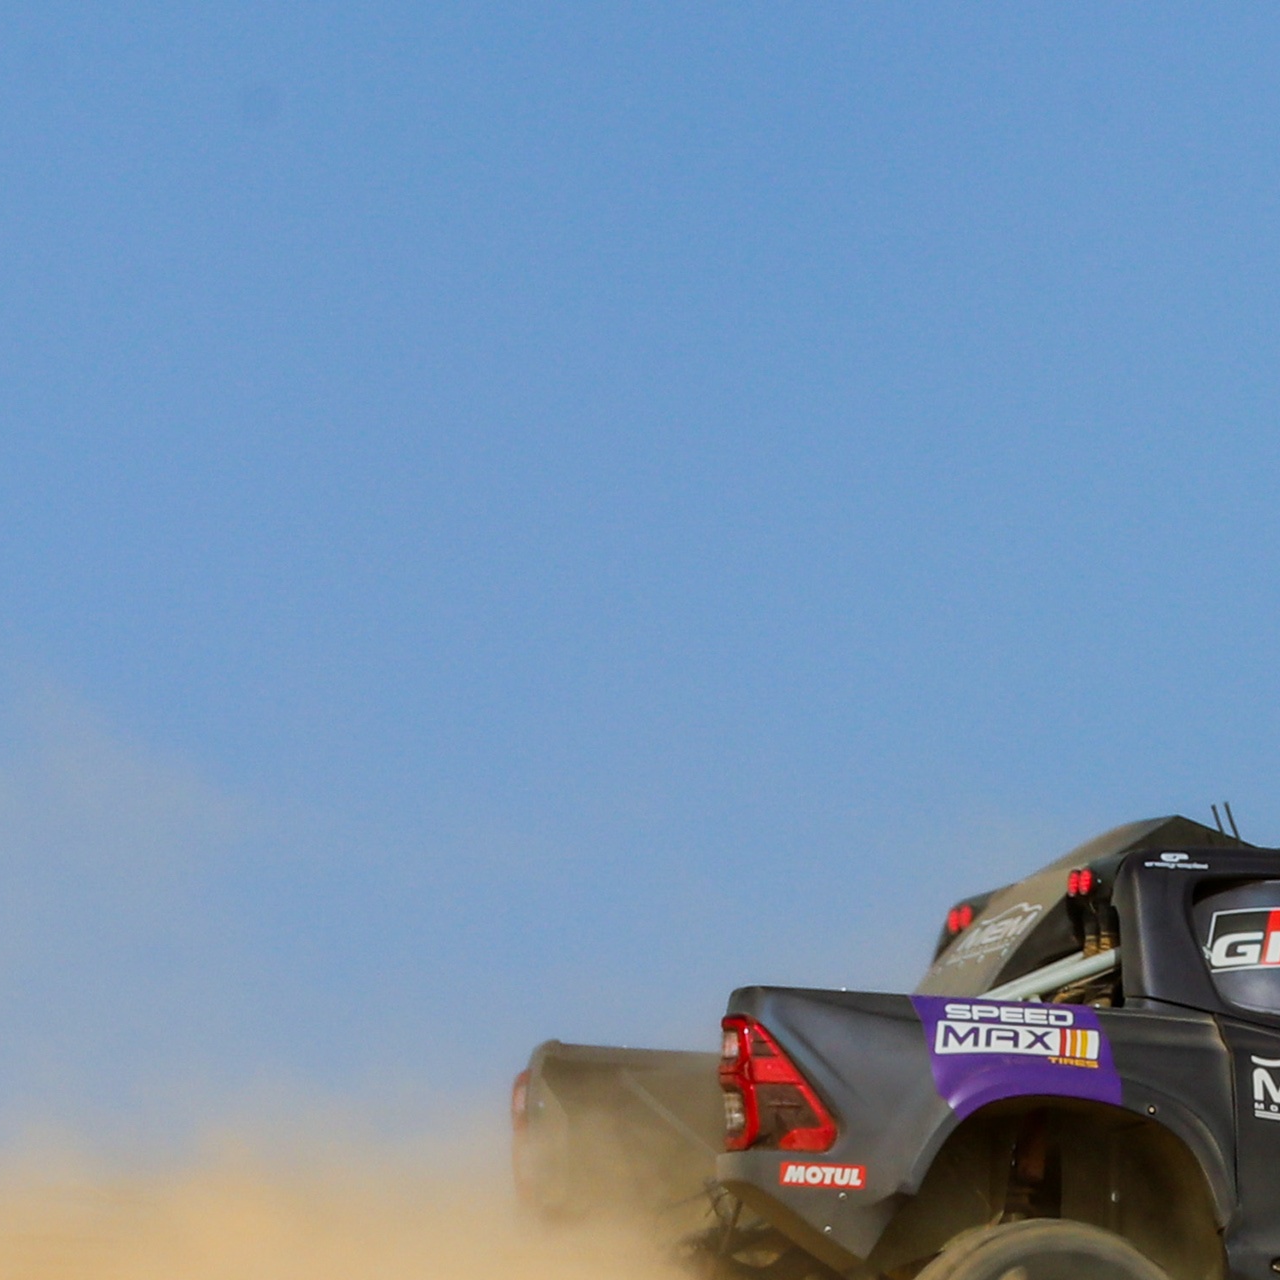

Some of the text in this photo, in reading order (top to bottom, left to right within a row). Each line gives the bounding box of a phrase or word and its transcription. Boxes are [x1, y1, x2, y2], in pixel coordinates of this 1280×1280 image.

[944, 1003, 1074, 1027] SPEED
[941, 1024, 1054, 1051] MAX
[1047, 1056, 1099, 1068] TIRES
[782, 1165, 863, 1187] MOTUL
